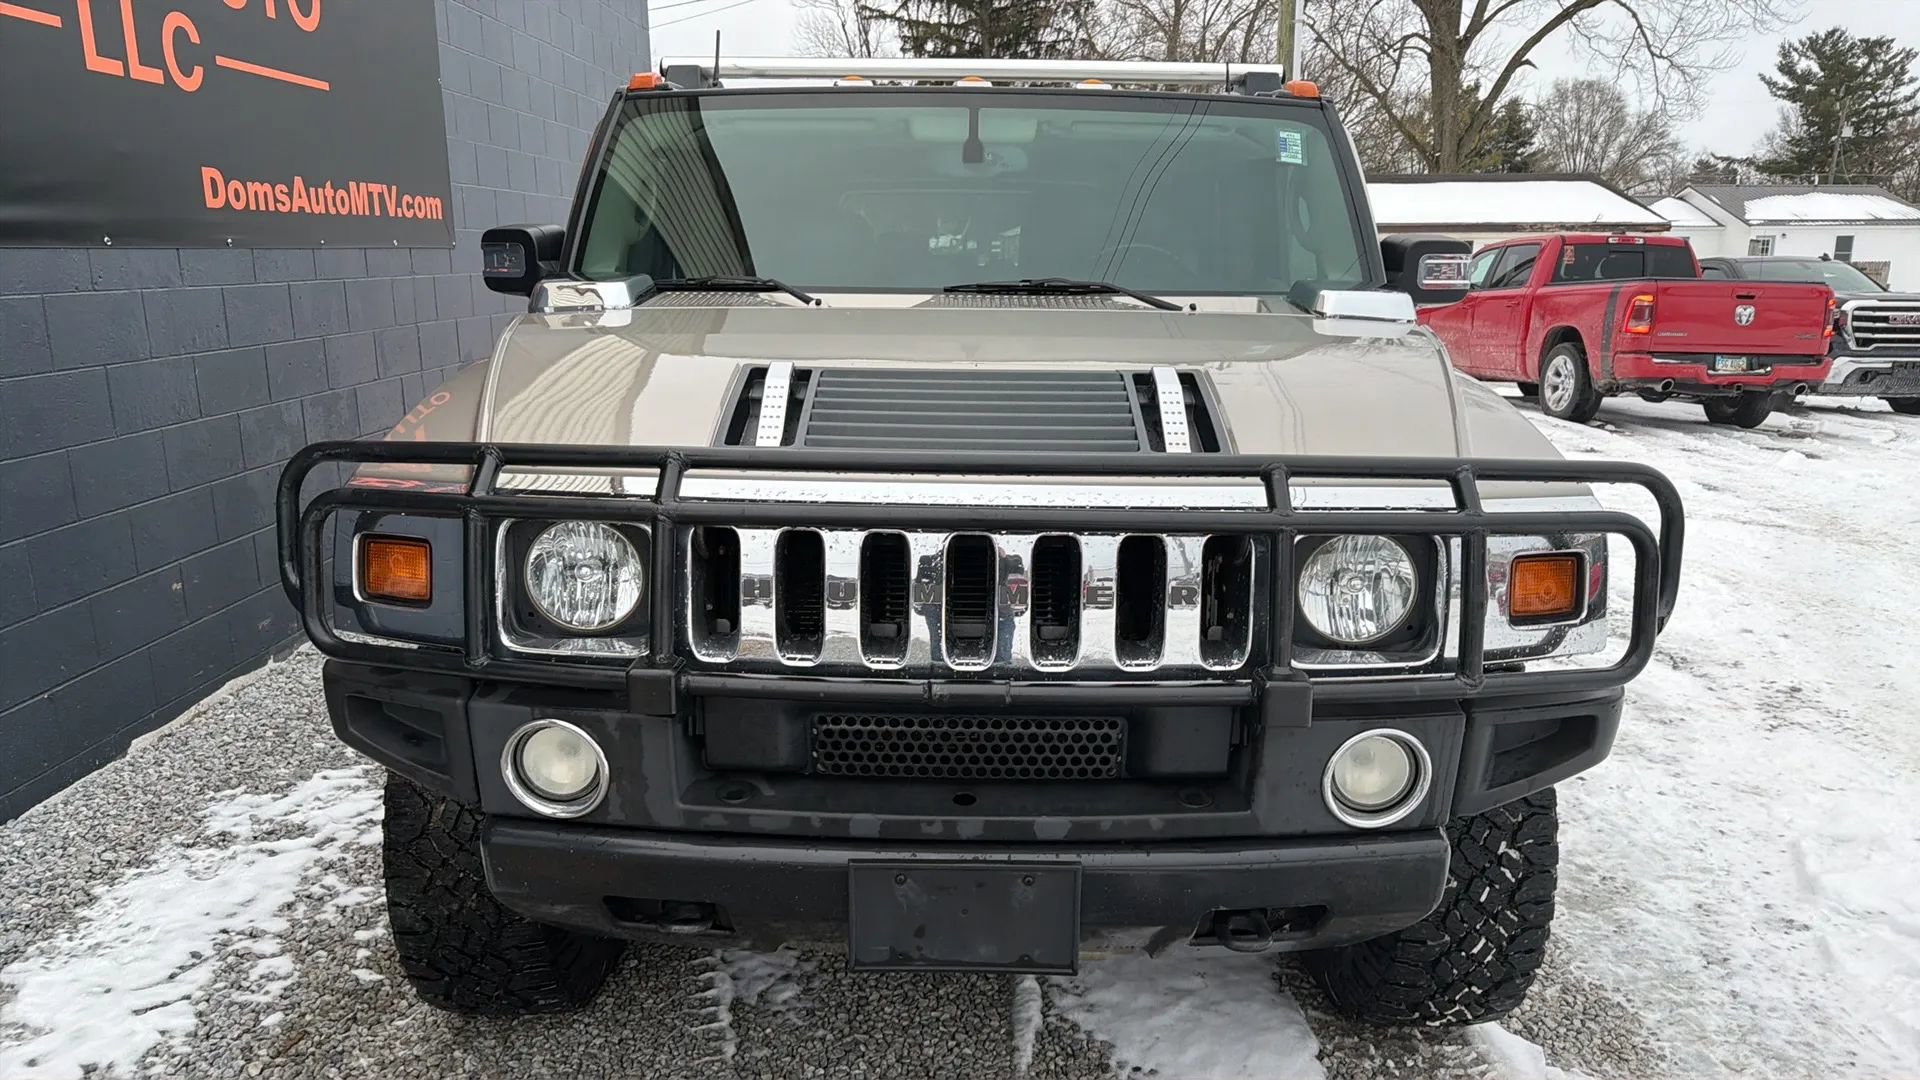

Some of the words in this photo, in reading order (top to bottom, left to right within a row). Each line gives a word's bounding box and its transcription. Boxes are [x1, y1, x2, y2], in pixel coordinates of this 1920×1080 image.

[77, 0, 204, 92] LLC
[201, 166, 443, 220] DomsAutoMTV.com
[743, 578, 1199, 606] HUMMER
